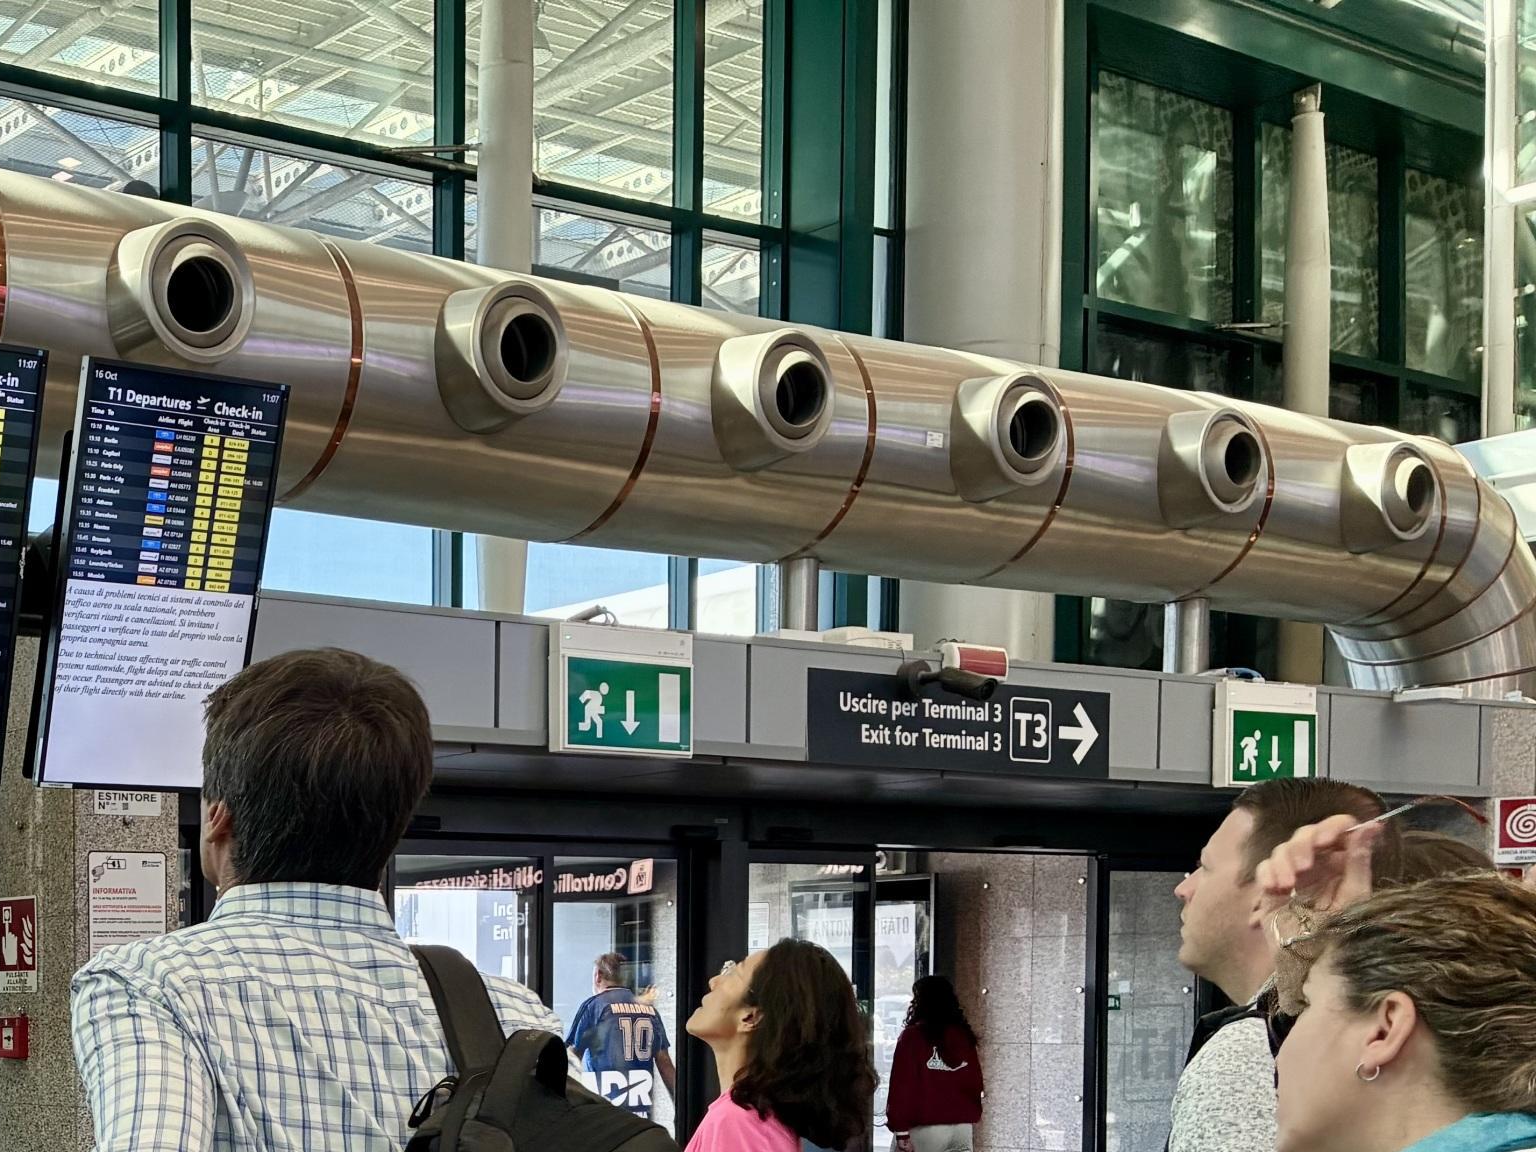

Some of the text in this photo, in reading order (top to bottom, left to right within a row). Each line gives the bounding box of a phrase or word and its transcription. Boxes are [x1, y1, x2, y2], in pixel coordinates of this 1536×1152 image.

[18, 358, 37, 369] 11:07
[95, 369, 118, 380] 16 Oct
[107, 386, 262, 420] T1 Departures Check-in
[262, 393, 280, 403] 11:07
[104, 590, 135, 599] problemi
[234, 600, 244, 608] del
[66, 598, 91, 608] traffico
[179, 609, 215, 617] potrebbero
[65, 611, 99, 619] verificarsi
[63, 624, 100, 632] passeggeri
[109, 626, 140, 635] verificare
[62, 635, 87, 643] propria
[89, 638, 126, 646] compagnia
[59, 649, 73, 657] Due
[84, 651, 116, 660] technical
[139, 655, 168, 665] affecting
[181, 658, 201, 667] traffic
[125, 665, 145, 675] flight
[147, 667, 167, 676] delays
[184, 671, 226, 679] cancellations
[56, 674, 71, 682] may
[95, 675, 133, 685] Passengers
[148, 679, 174, 687] advised
[63, 684, 80, 692] their
[80, 686, 100, 695] flight
[101, 687, 126, 697] directly
[839, 691, 1002, 722] Uscire per Terminal 3
[1014, 712, 1047, 748] T3
[861, 724, 1002, 751] Exit for Terminal 3
[98, 792, 157, 802] ESTINTORE
[92, 888, 136, 896] INFORMATIVA
[619, 1017, 654, 1061] 10
